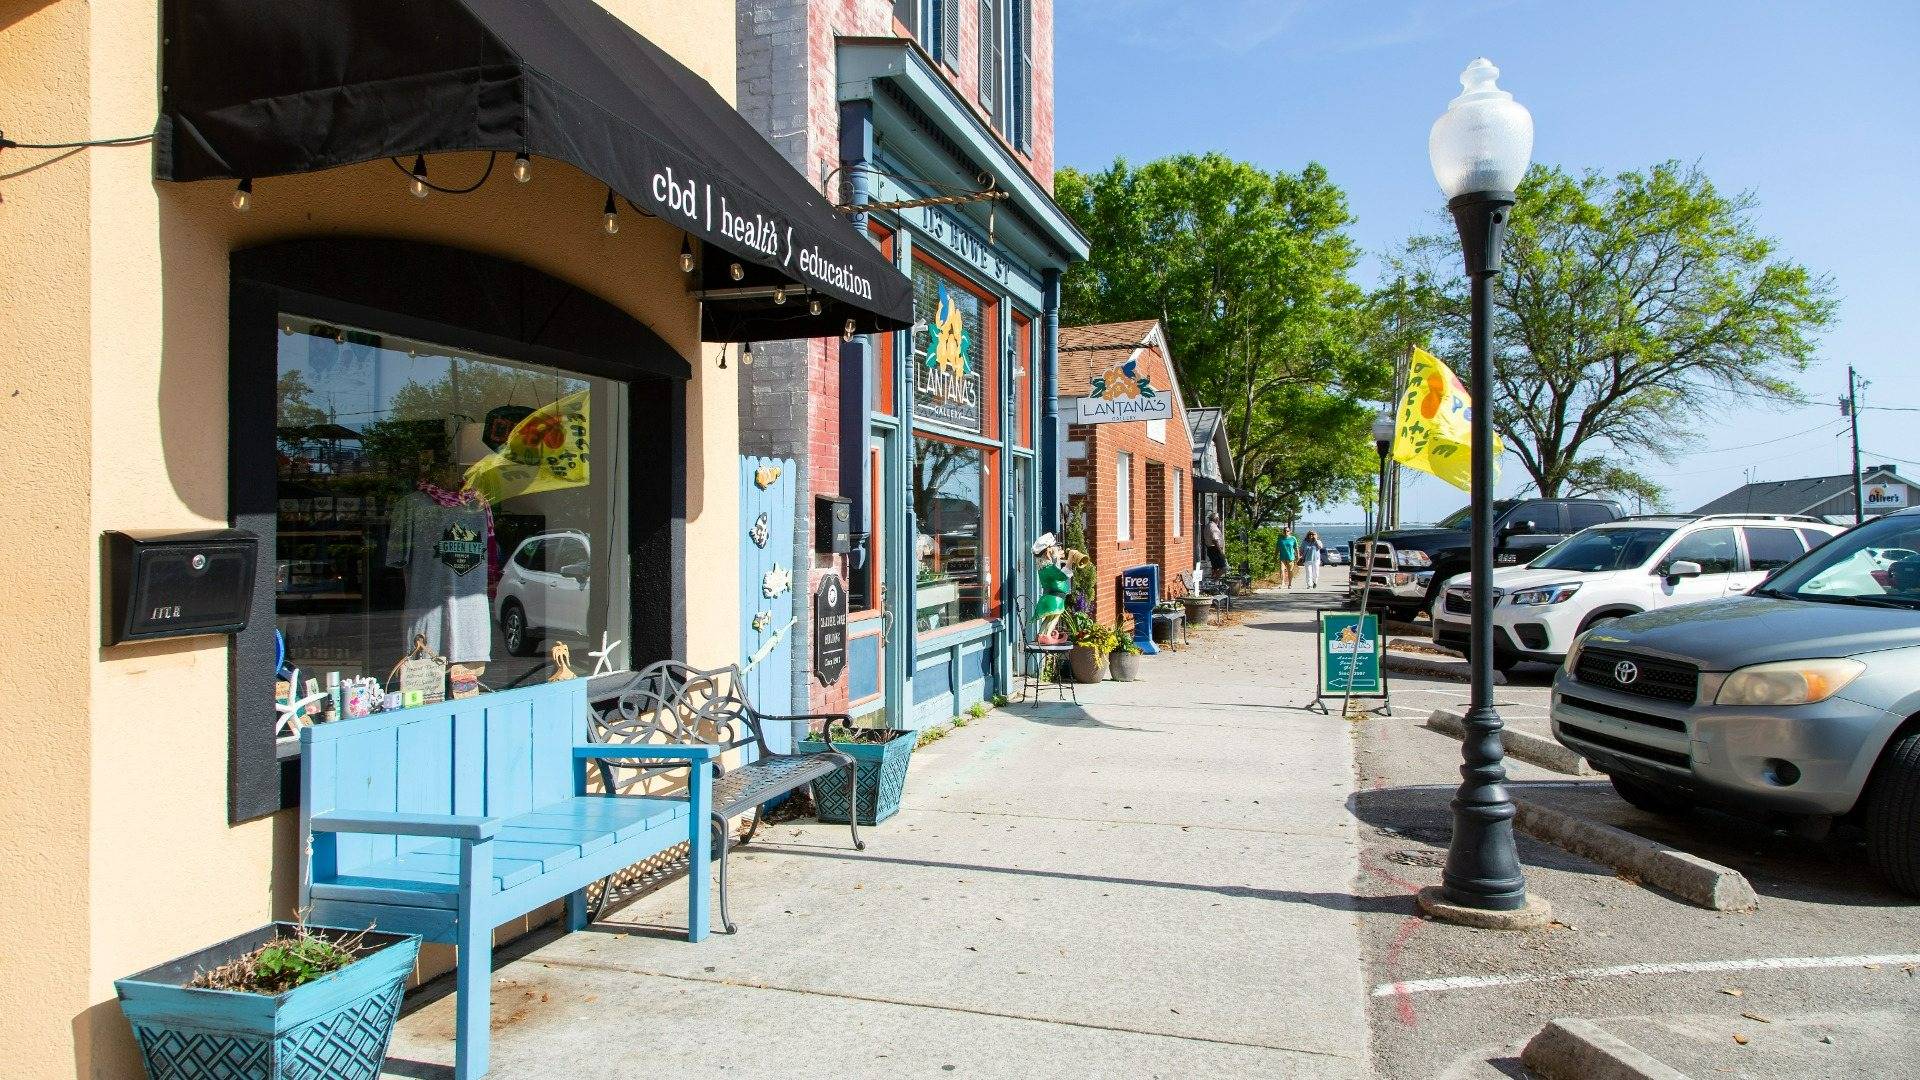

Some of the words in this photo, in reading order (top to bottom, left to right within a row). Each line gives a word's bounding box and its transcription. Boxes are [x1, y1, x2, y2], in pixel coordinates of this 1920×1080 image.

[653, 167, 697, 219] cbd
[720, 196, 777, 255] health
[800, 246, 872, 299] education
[949, 220, 987, 269] HOWE
[994, 258, 1010, 285] ST
[917, 361, 977, 408] LANTANA'S
[1083, 397, 1166, 417] LANTANA'S
[1868, 493, 1900, 503] Oliver's
[443, 541, 466, 552] GREEN
[1125, 576, 1149, 588] Free
